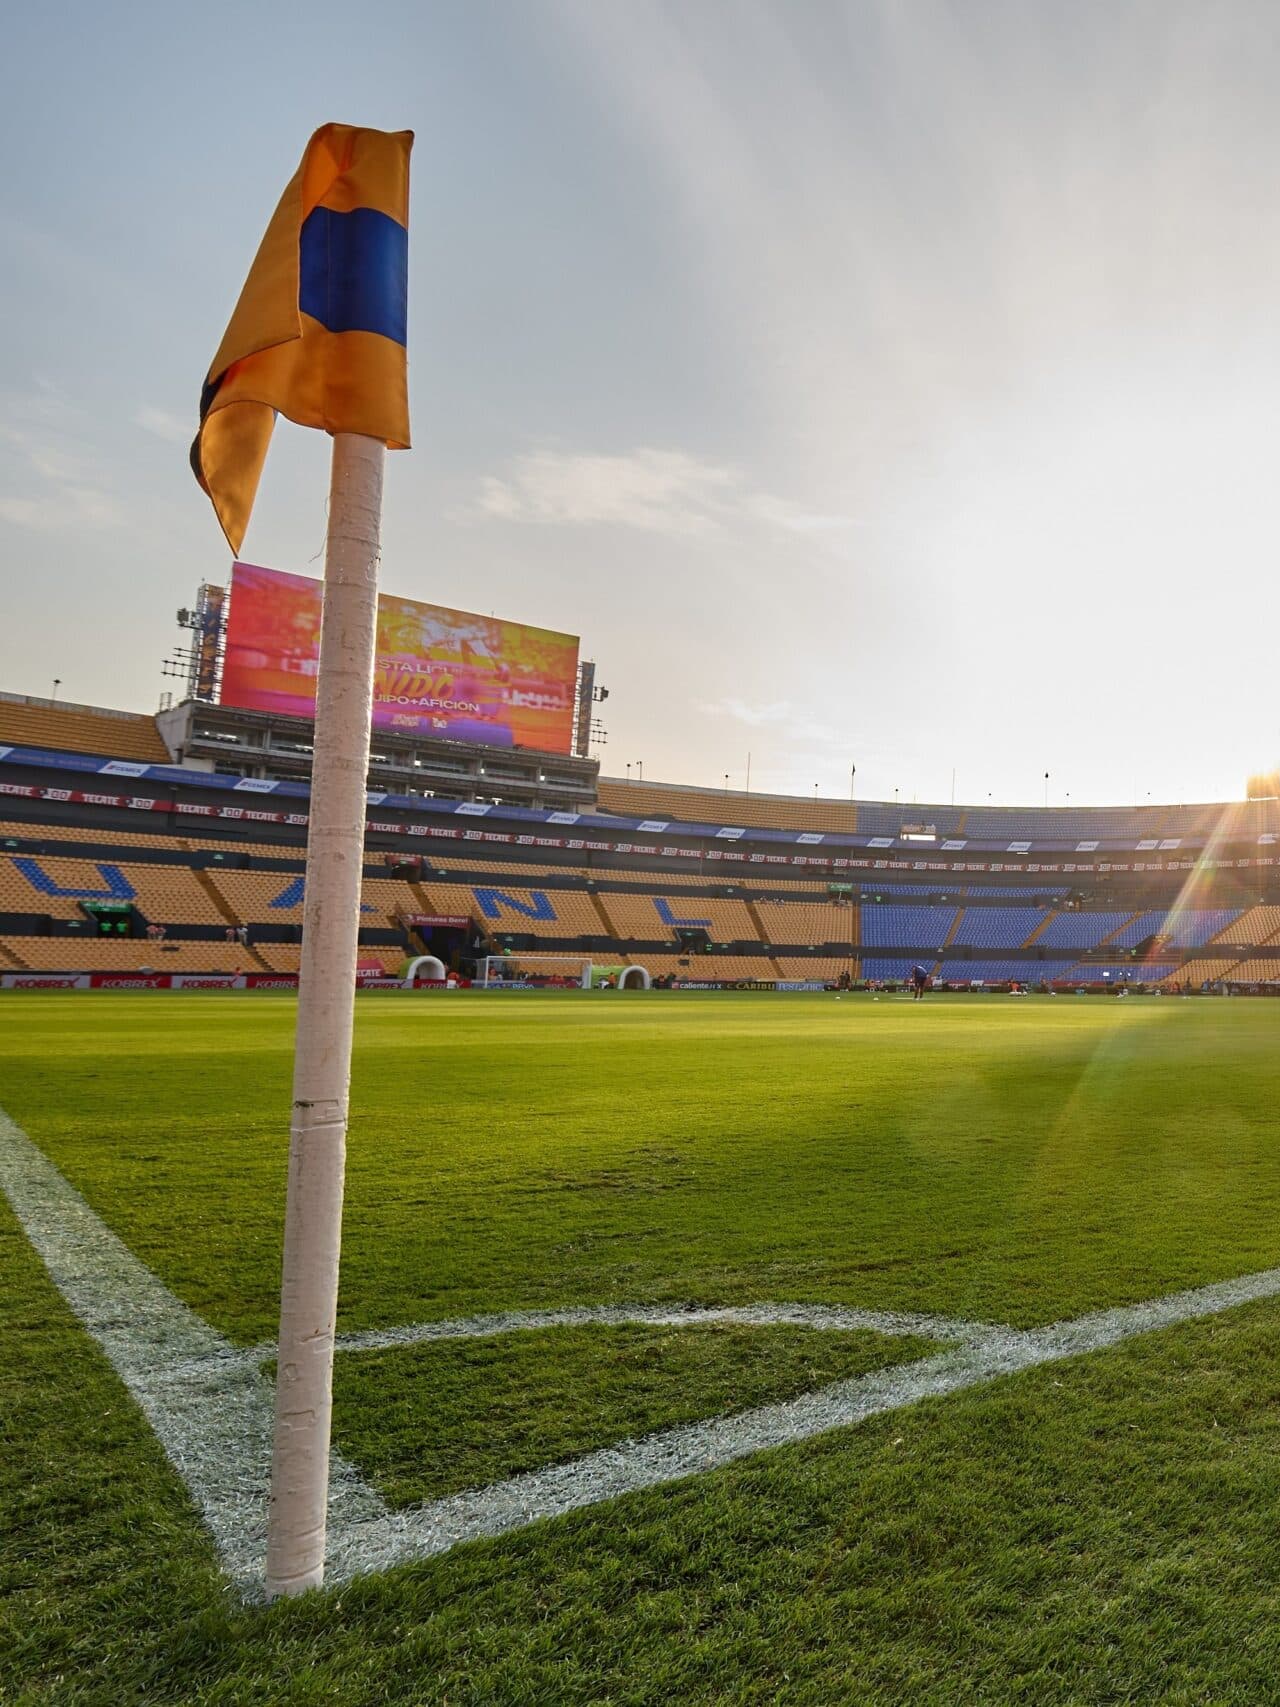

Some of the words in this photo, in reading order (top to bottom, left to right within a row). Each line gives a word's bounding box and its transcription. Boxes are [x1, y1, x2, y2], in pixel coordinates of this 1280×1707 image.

[81, 794, 120, 805] TECATE
[176, 803, 211, 815] TECATE
[245, 810, 277, 822] TECATE
[371, 822, 401, 833] TECATE
[429, 828, 457, 838] TECATE
[484, 833, 512, 842] TECATE
[536, 838, 561, 847] TECATE
[586, 841, 610, 850] TECATE
[633, 845, 657, 854] TECATE
[680, 849, 702, 858] TECATE
[724, 852, 745, 861] TECATE
[767, 856, 788, 864] TECATE
[471, 887, 558, 921] N
[14, 977, 80, 989] KOBREX
[101, 978, 161, 988] KOBREX
[181, 977, 238, 988] KOBREX
[255, 979, 298, 989] KOBRE
